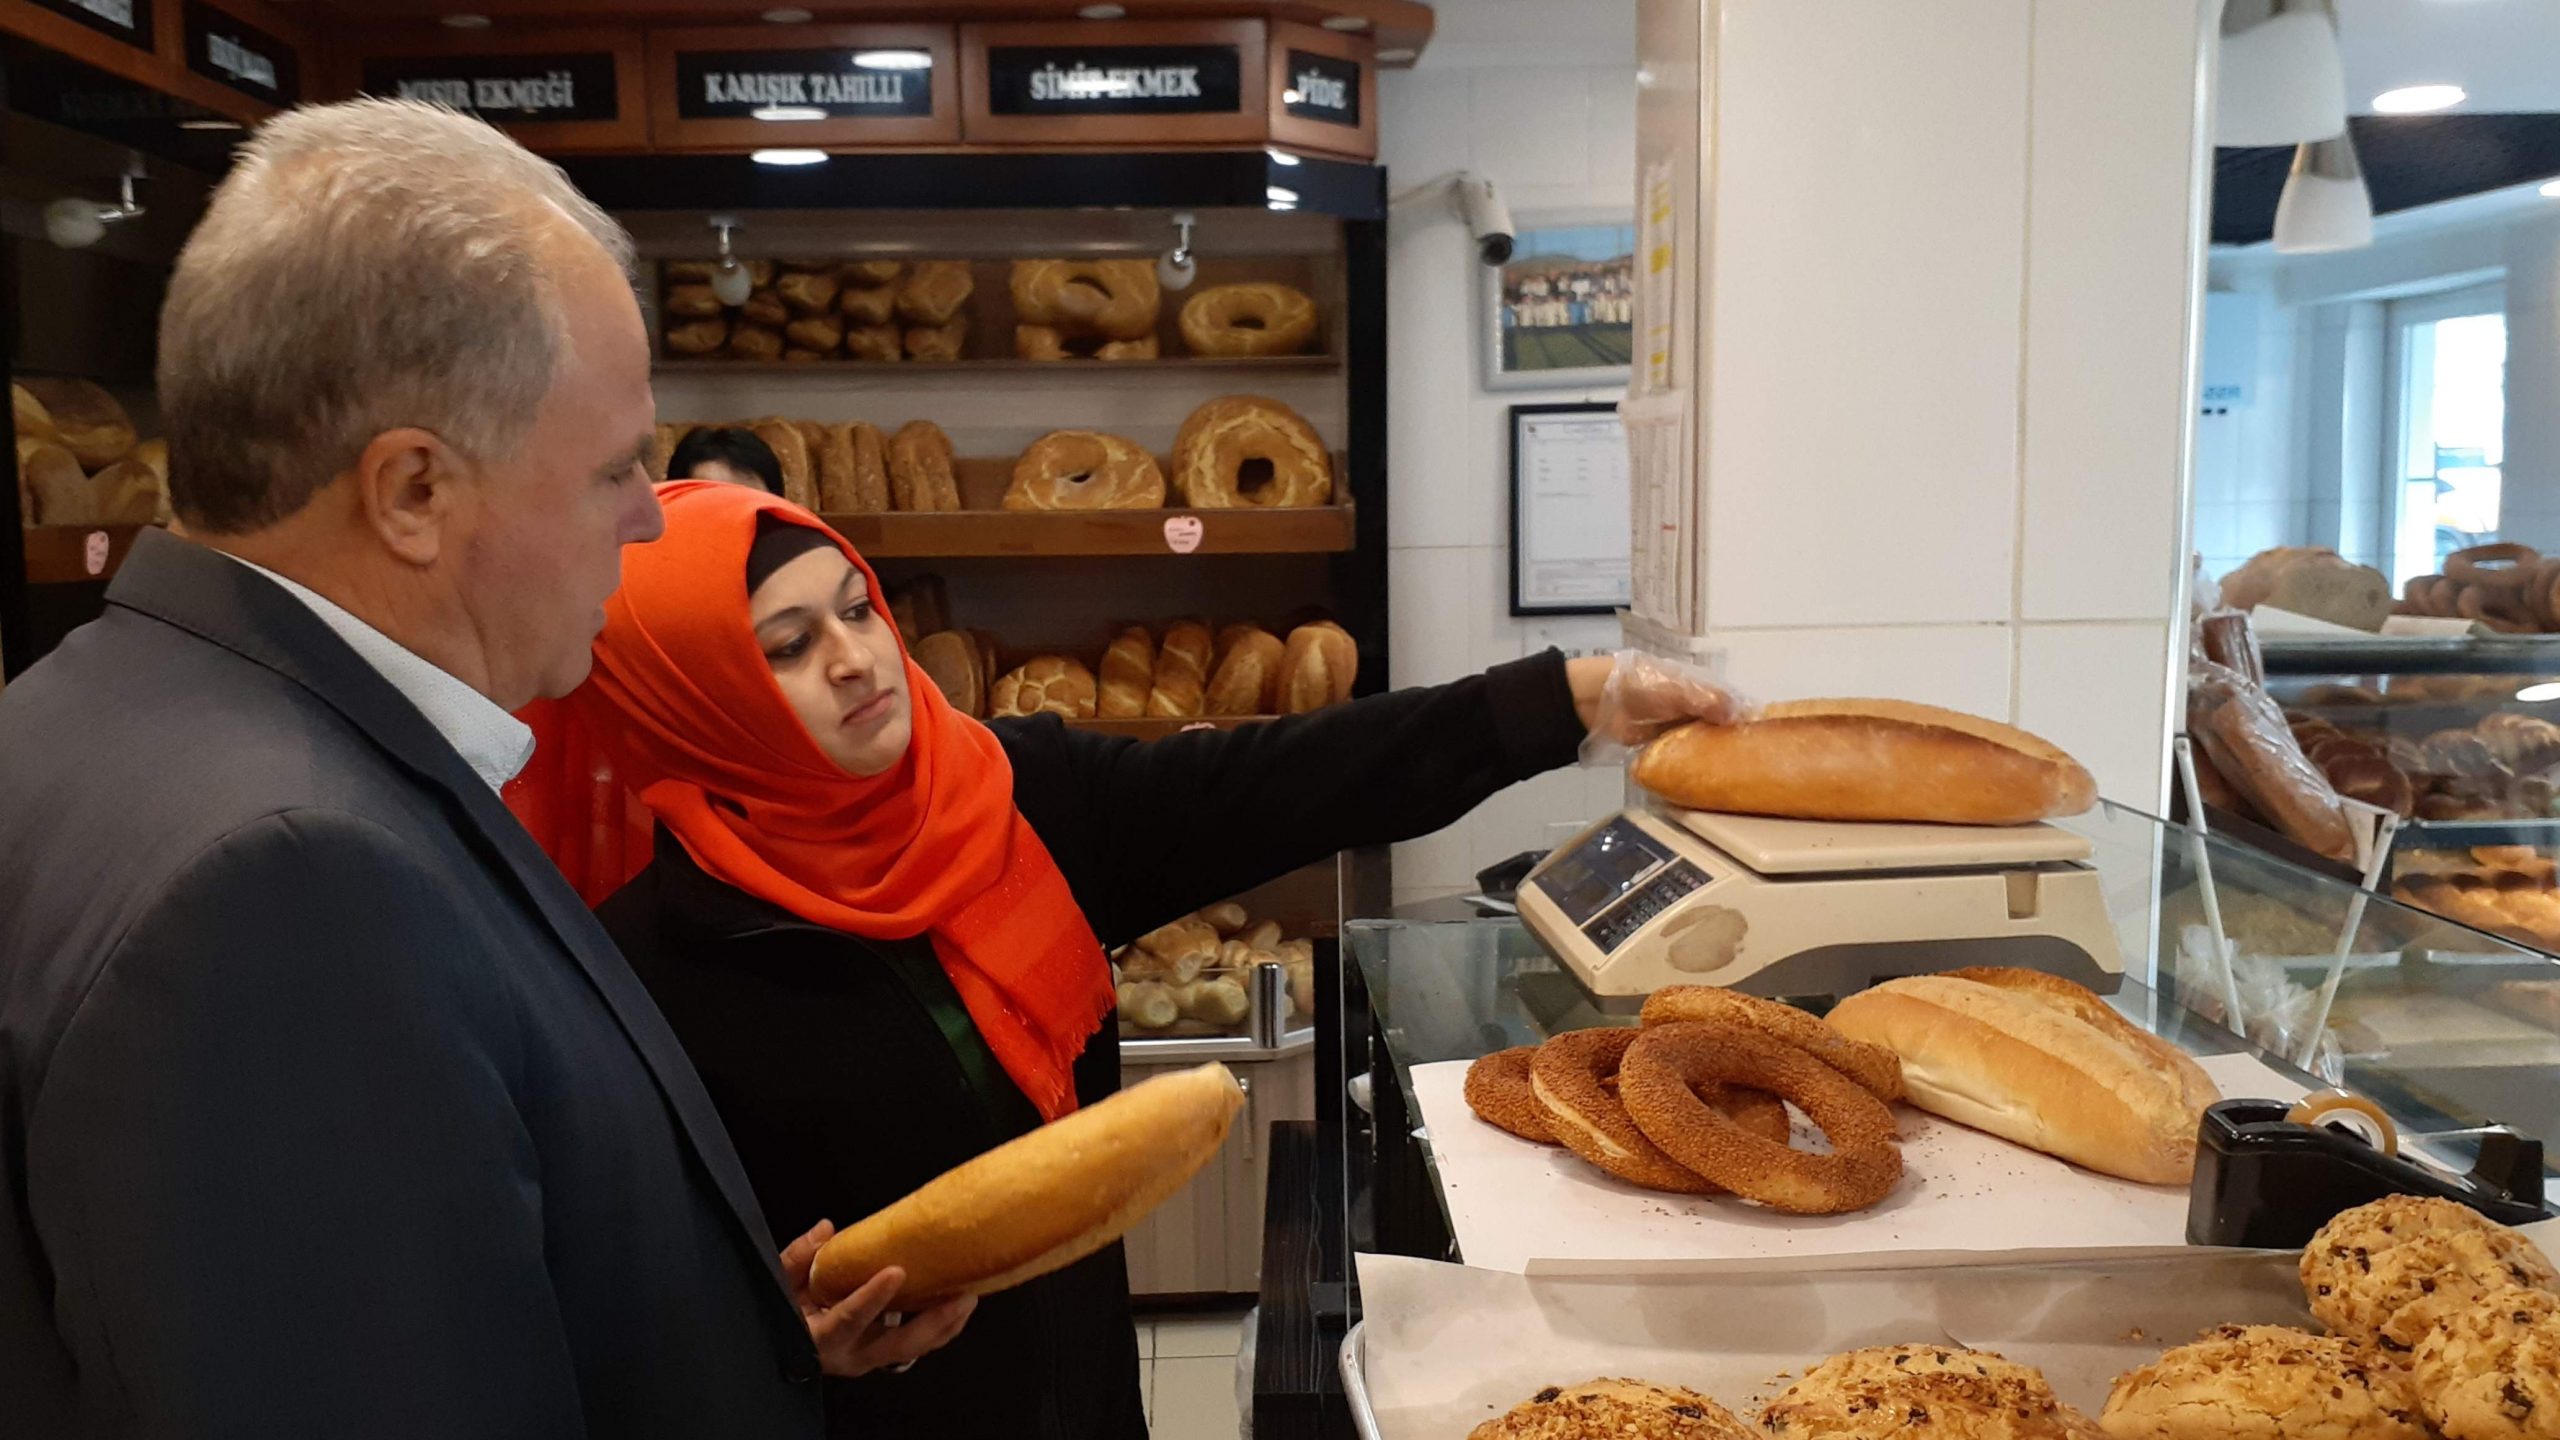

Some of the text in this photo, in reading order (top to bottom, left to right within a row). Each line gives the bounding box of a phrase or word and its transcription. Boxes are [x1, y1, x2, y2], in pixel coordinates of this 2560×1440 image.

[474, 71, 575, 108] EKMEĞİ
[810, 72, 904, 103] TAHILLI
[1107, 67, 1201, 98] EKMEK
[1297, 68, 1346, 109] PİDE
